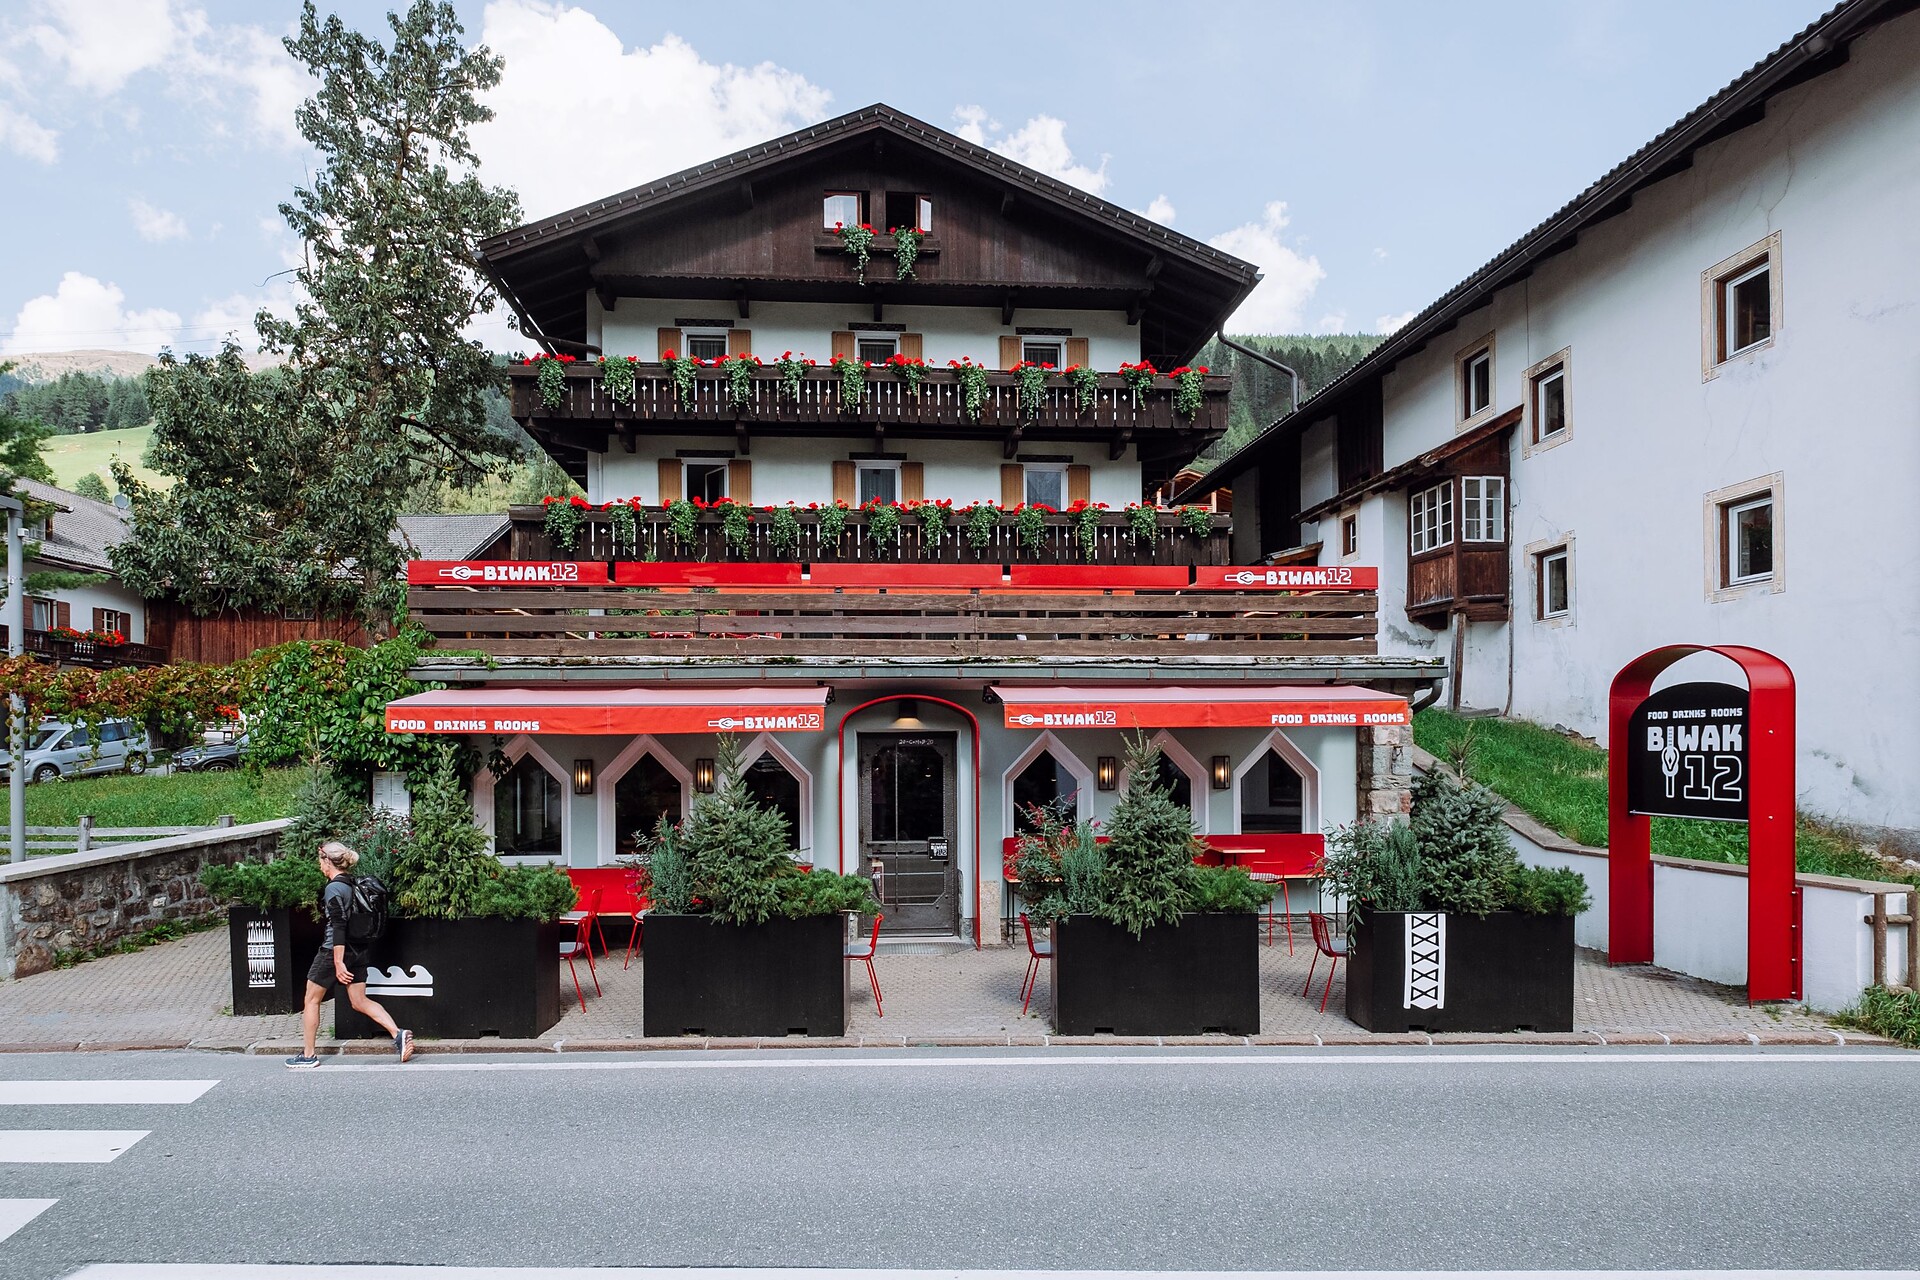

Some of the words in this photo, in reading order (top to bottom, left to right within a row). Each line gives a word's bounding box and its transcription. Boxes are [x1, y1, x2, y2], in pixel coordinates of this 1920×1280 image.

[1271, 714, 1303, 724] FOOD
[1310, 713, 1357, 724] DRINKS
[1363, 713, 1405, 723] ROOMS
[1647, 711, 1668, 720] FOOD
[1672, 709, 1706, 719] DRINKS
[1711, 708, 1743, 717] ROOMS
[390, 719, 426, 730] FOOD
[433, 720, 487, 731] DRINKS
[493, 720, 541, 731] ROOMS
[1647, 724, 1743, 752] BIWAK
[1683, 755, 1742, 802] 12
